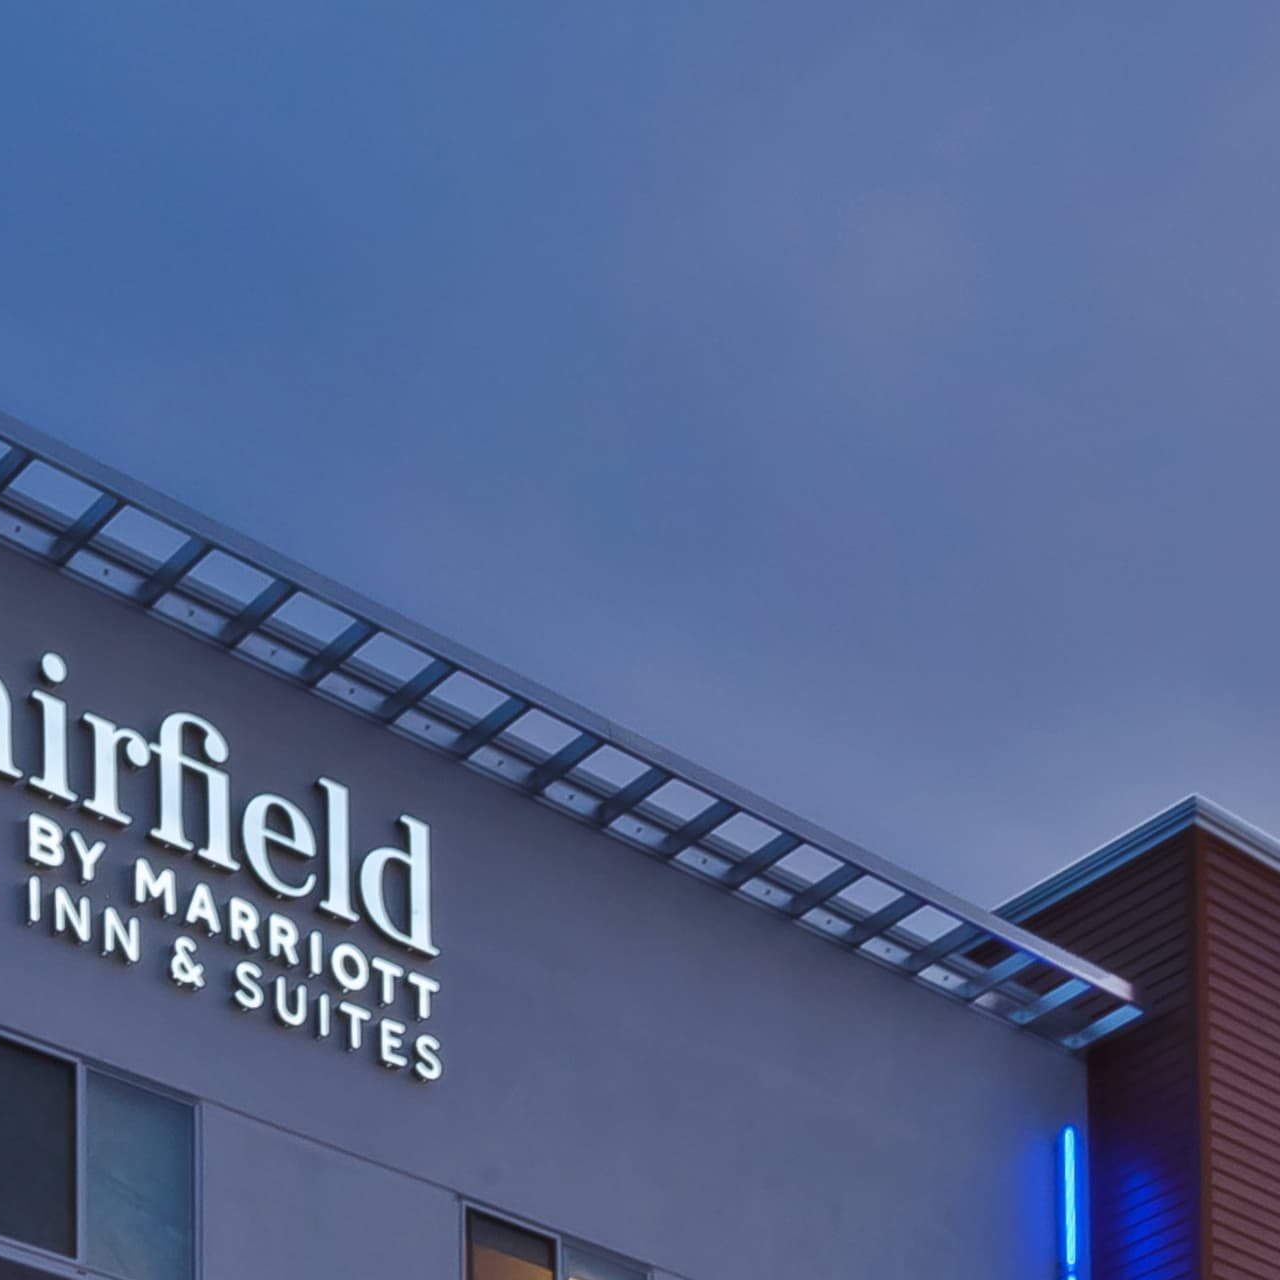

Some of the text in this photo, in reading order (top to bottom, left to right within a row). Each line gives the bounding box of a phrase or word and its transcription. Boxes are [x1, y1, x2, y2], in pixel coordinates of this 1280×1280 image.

[28, 812, 441, 1020] BY MARRIOTT
[28, 875, 443, 1081] INN & SUITES
